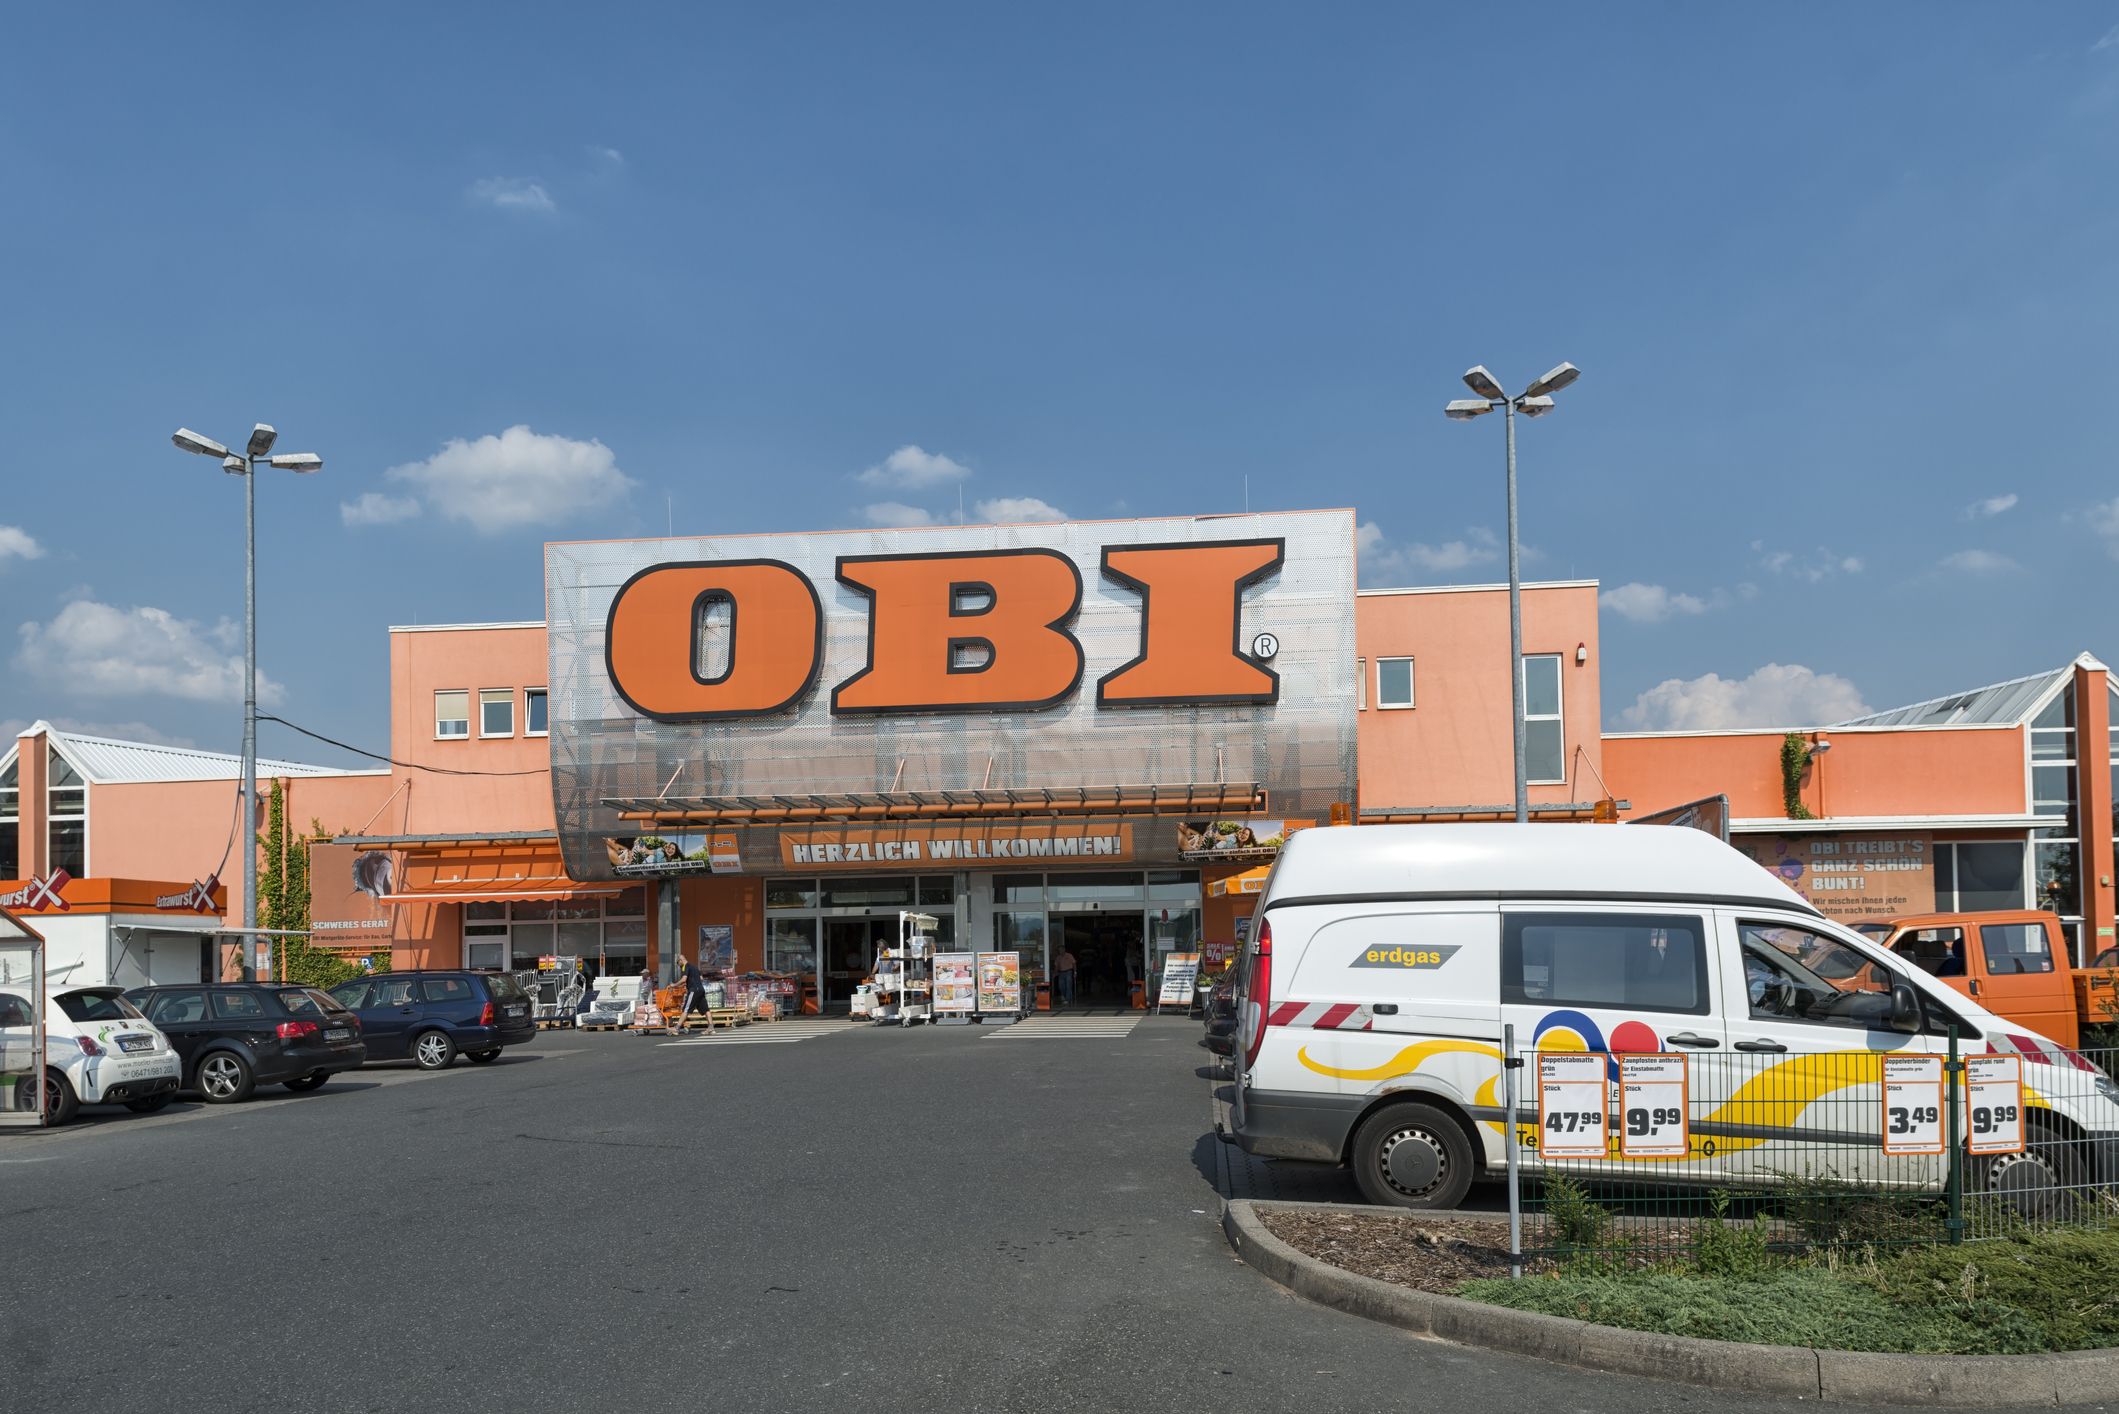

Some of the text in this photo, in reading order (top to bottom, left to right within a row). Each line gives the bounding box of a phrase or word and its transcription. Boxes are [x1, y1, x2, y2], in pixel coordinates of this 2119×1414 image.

[605, 537, 1285, 722] OBI
[792, 836, 1121, 863] HERZLICH WILLKOMMEN!
[1810, 840, 1924, 855] OBI TREIBT'S
[1811, 856, 1923, 873] GANZ SCHÖN
[1812, 877, 1865, 890] BUNT!
[1813, 897, 1826, 905] Wir
[1885, 896, 1907, 905] jeden
[313, 921, 359, 929] SCHWERES
[1366, 946, 1441, 967] erdgas
[1540, 1056, 1594, 1064] Doppelstabmatte
[1541, 1065, 1555, 1073] grün
[1545, 1112, 1602, 1132] 47,99
[1627, 1108, 1681, 1136] 9,99
[1889, 1107, 1938, 1134] 3,49
[1973, 1106, 2018, 1133] 9,99
